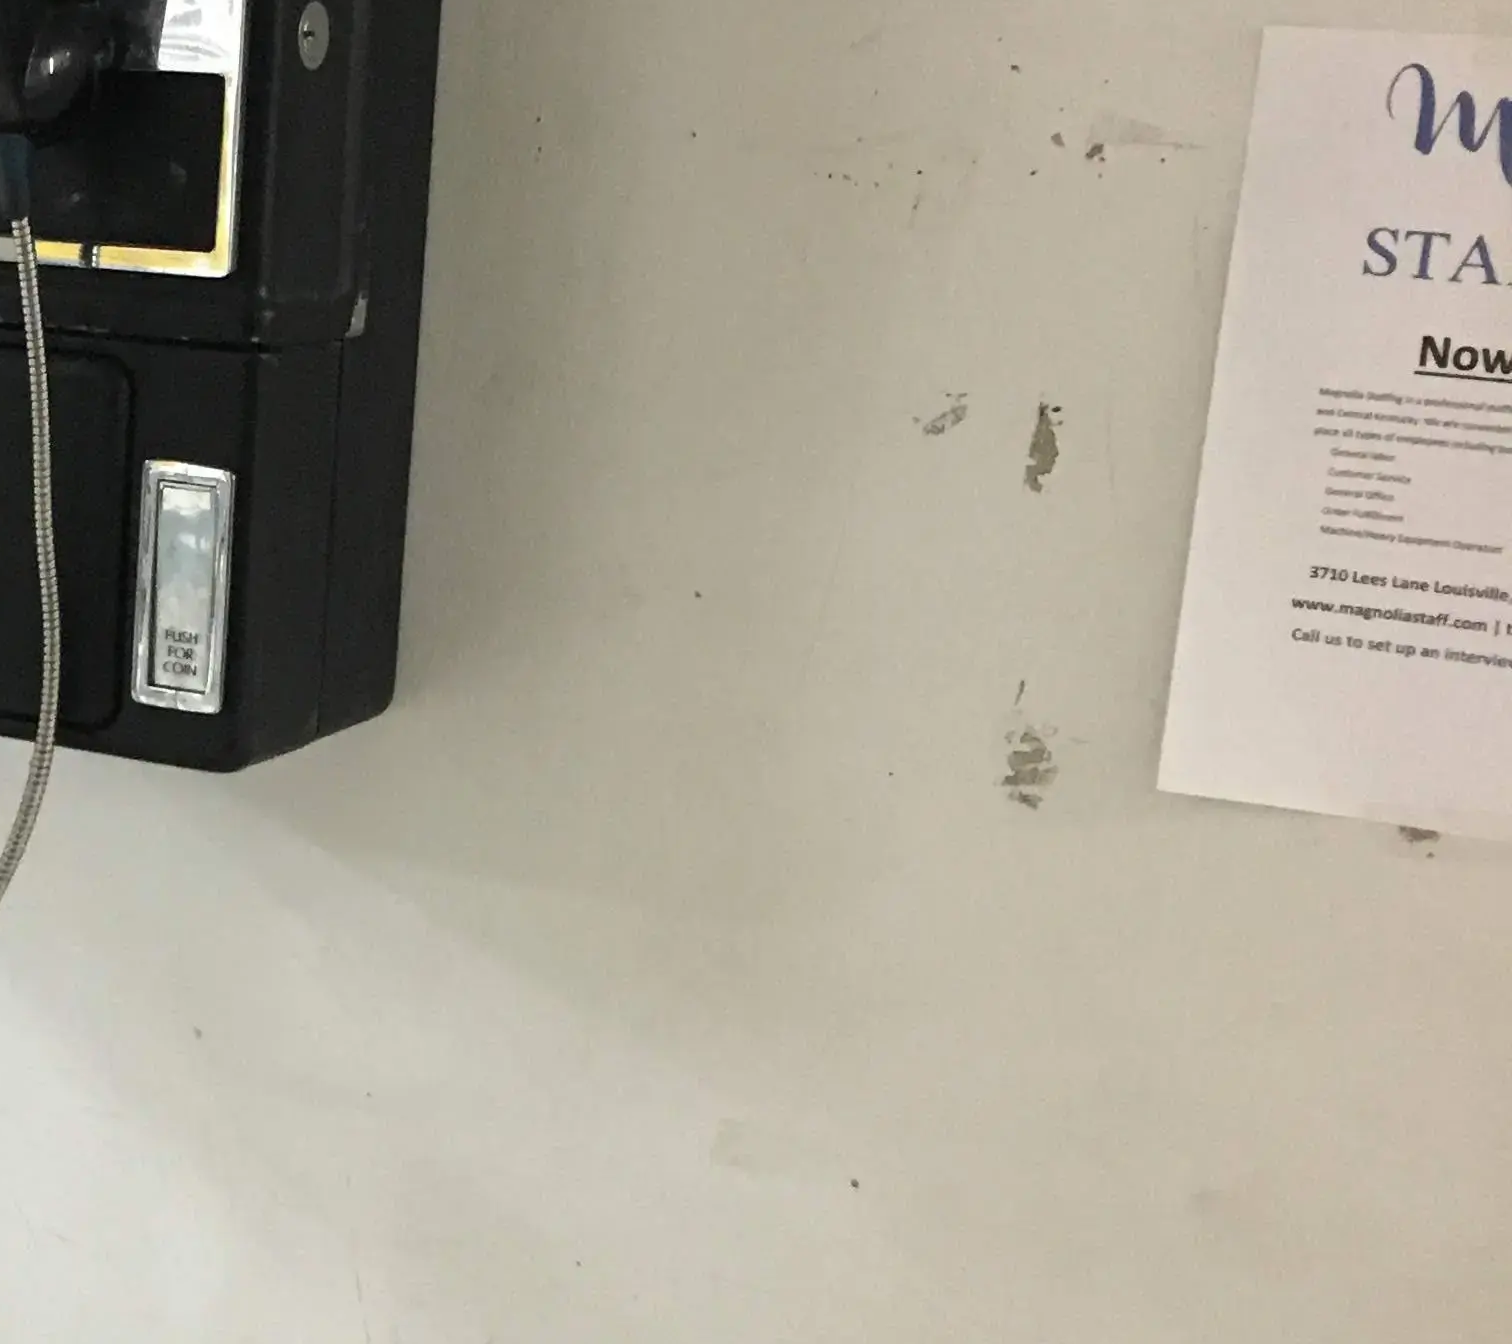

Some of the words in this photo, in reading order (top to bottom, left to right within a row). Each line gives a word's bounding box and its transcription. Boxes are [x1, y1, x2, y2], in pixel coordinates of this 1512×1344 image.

[1362, 227, 1512, 286] STA
[1419, 335, 1512, 376] Now
[1309, 565, 1349, 582] 3710
[1352, 571, 1388, 587] Lees
[1391, 576, 1430, 592] Lane
[1291, 597, 1488, 632] www.magnoliastaff.com
[165, 628, 199, 645] PUSH
[1291, 628, 1320, 643] Call
[1325, 634, 1342, 646] us
[1346, 636, 1363, 649] to
[1367, 640, 1392, 653] set
[1395, 644, 1416, 658] up
[1420, 647, 1440, 659] an
[167, 645, 194, 660] FOR
[162, 660, 197, 676] COIN
